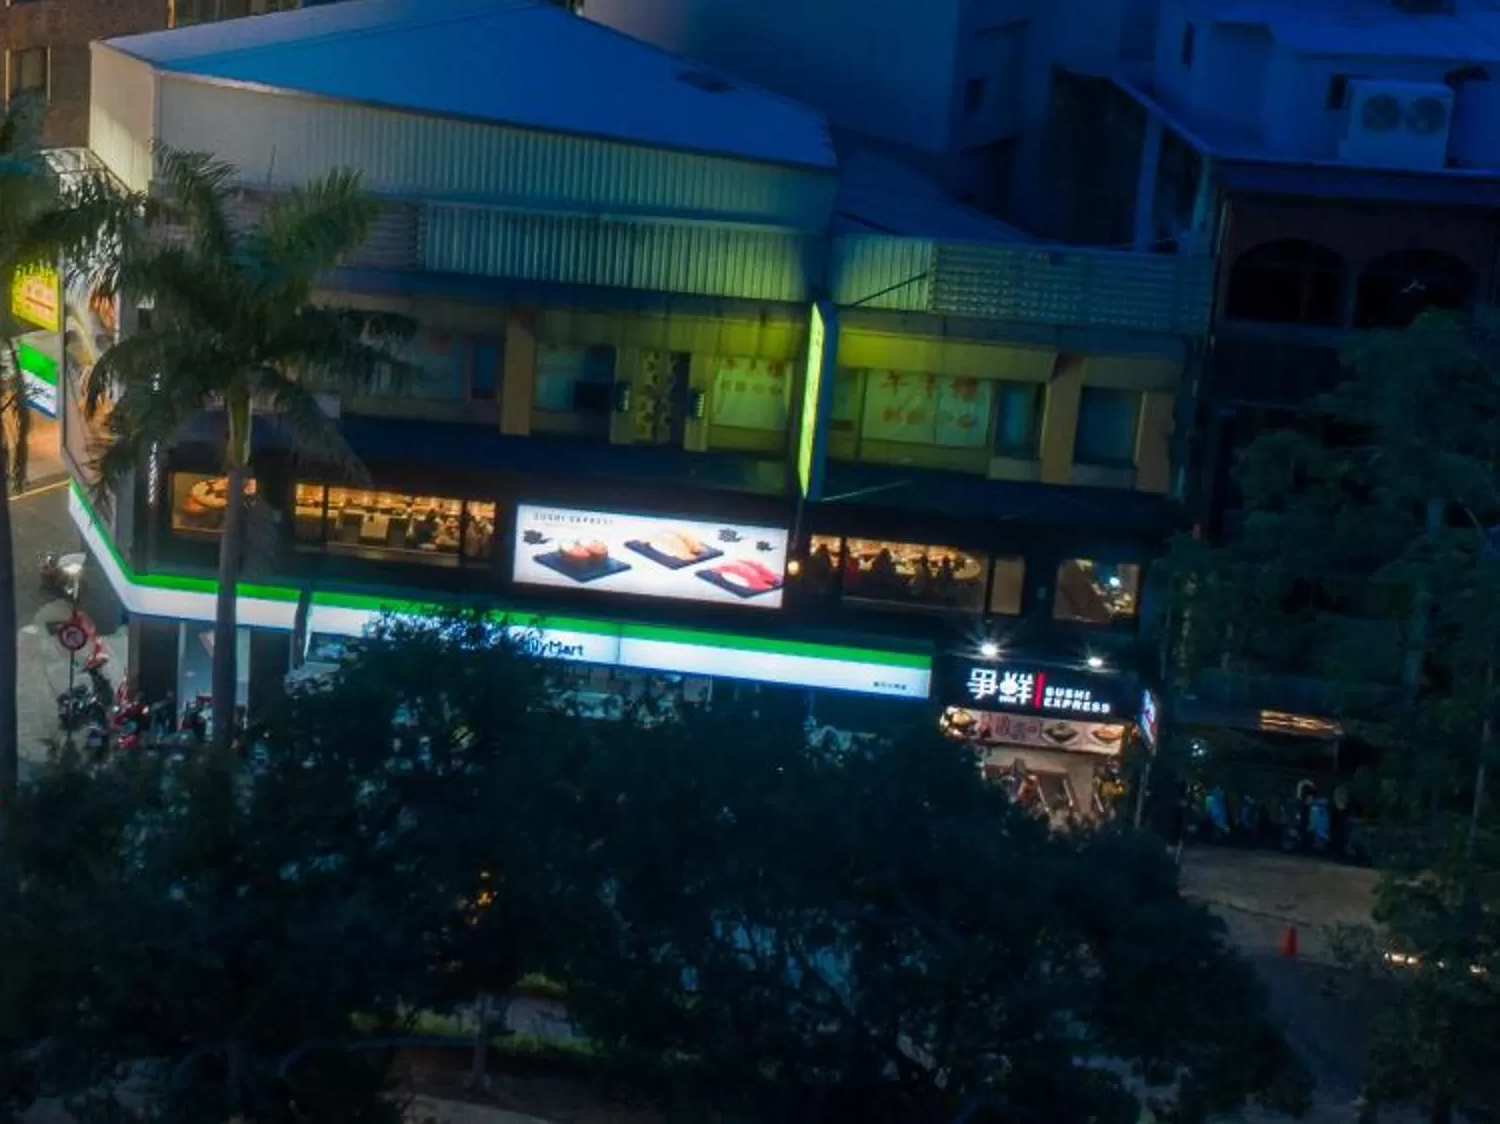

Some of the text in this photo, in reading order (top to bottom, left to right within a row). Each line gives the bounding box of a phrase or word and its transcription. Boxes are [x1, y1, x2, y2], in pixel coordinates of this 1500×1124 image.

[966, 667, 1034, 705] 爭鮮
[1045, 685, 1092, 701] SUSHI
[1043, 696, 1111, 714] EXPRESS
